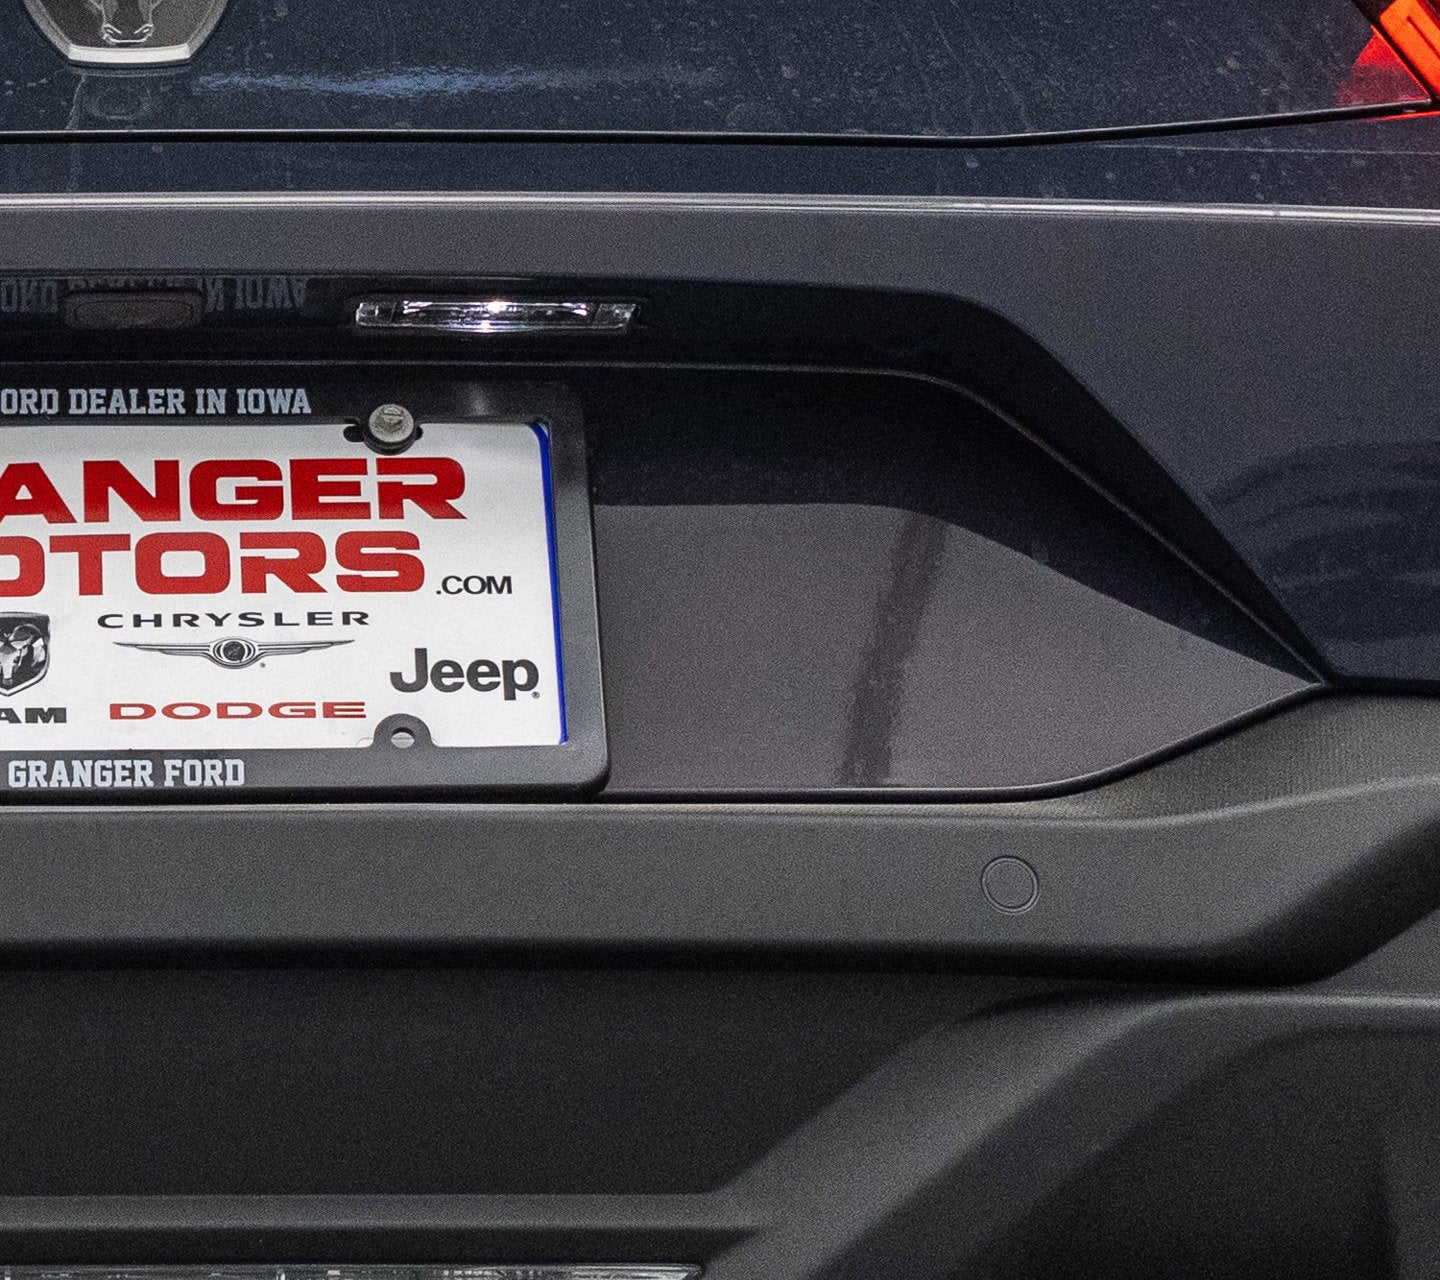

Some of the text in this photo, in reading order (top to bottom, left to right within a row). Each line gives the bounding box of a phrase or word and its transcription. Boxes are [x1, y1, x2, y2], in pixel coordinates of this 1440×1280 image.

[68, 388, 186, 415] DEALER
[196, 388, 226, 414] IN
[237, 388, 312, 414] IOWA
[435, 575, 513, 595] .COM
[97, 611, 370, 629] CHRYSLER
[390, 648, 539, 700] Jeep
[109, 701, 367, 720] DODGE
[8, 758, 245, 788] GRANGER FORD
